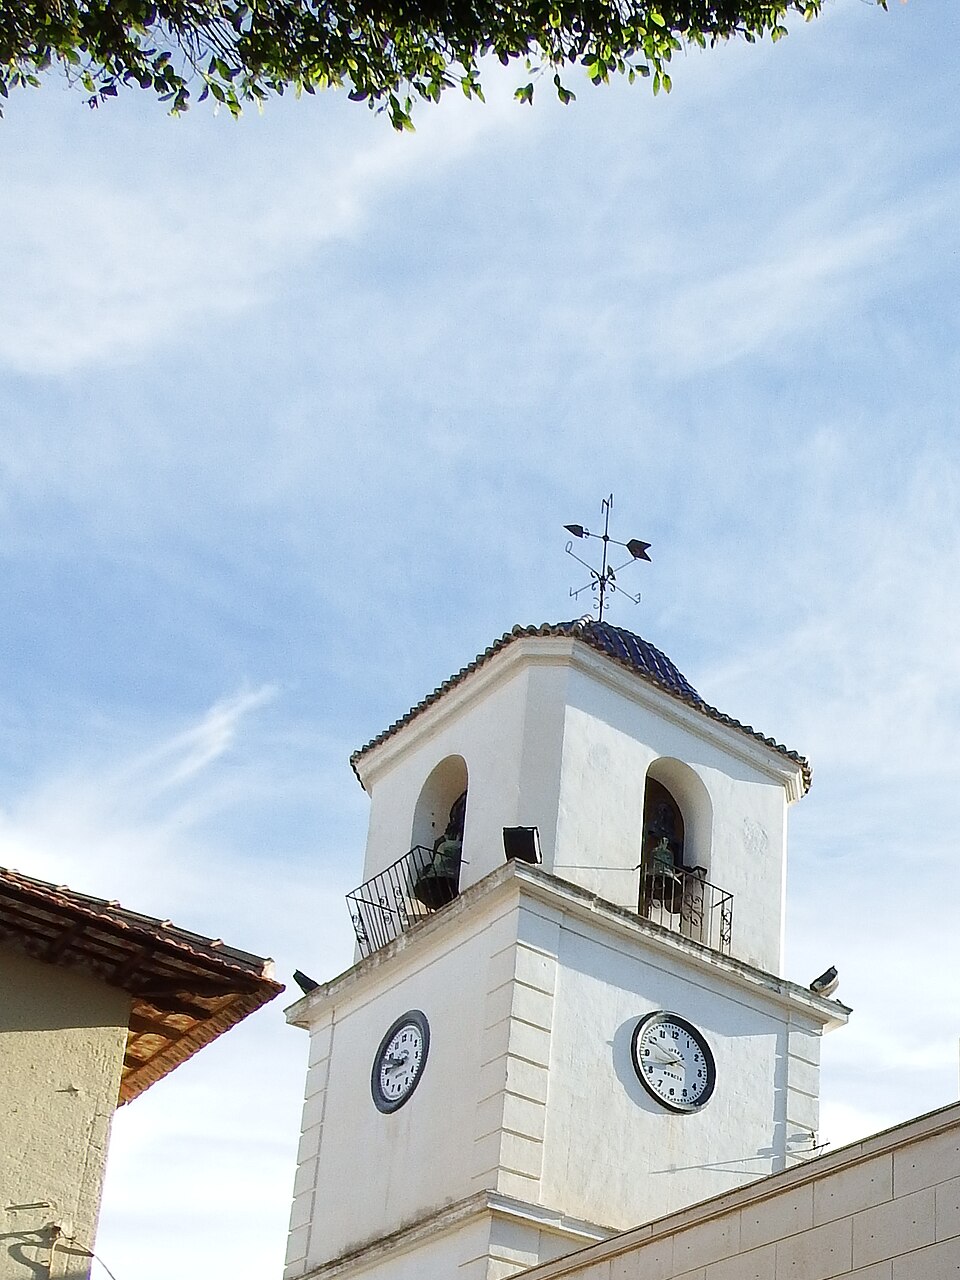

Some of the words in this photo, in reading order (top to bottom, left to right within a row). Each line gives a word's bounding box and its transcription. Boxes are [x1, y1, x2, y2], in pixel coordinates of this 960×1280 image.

[659, 1030, 666, 1039] 11
[671, 1031, 679, 1040] 12
[694, 1054, 699, 1062] 2
[697, 1069, 702, 1078] 3
[657, 1079, 663, 1087] 7
[692, 1083, 697, 1091] 4
